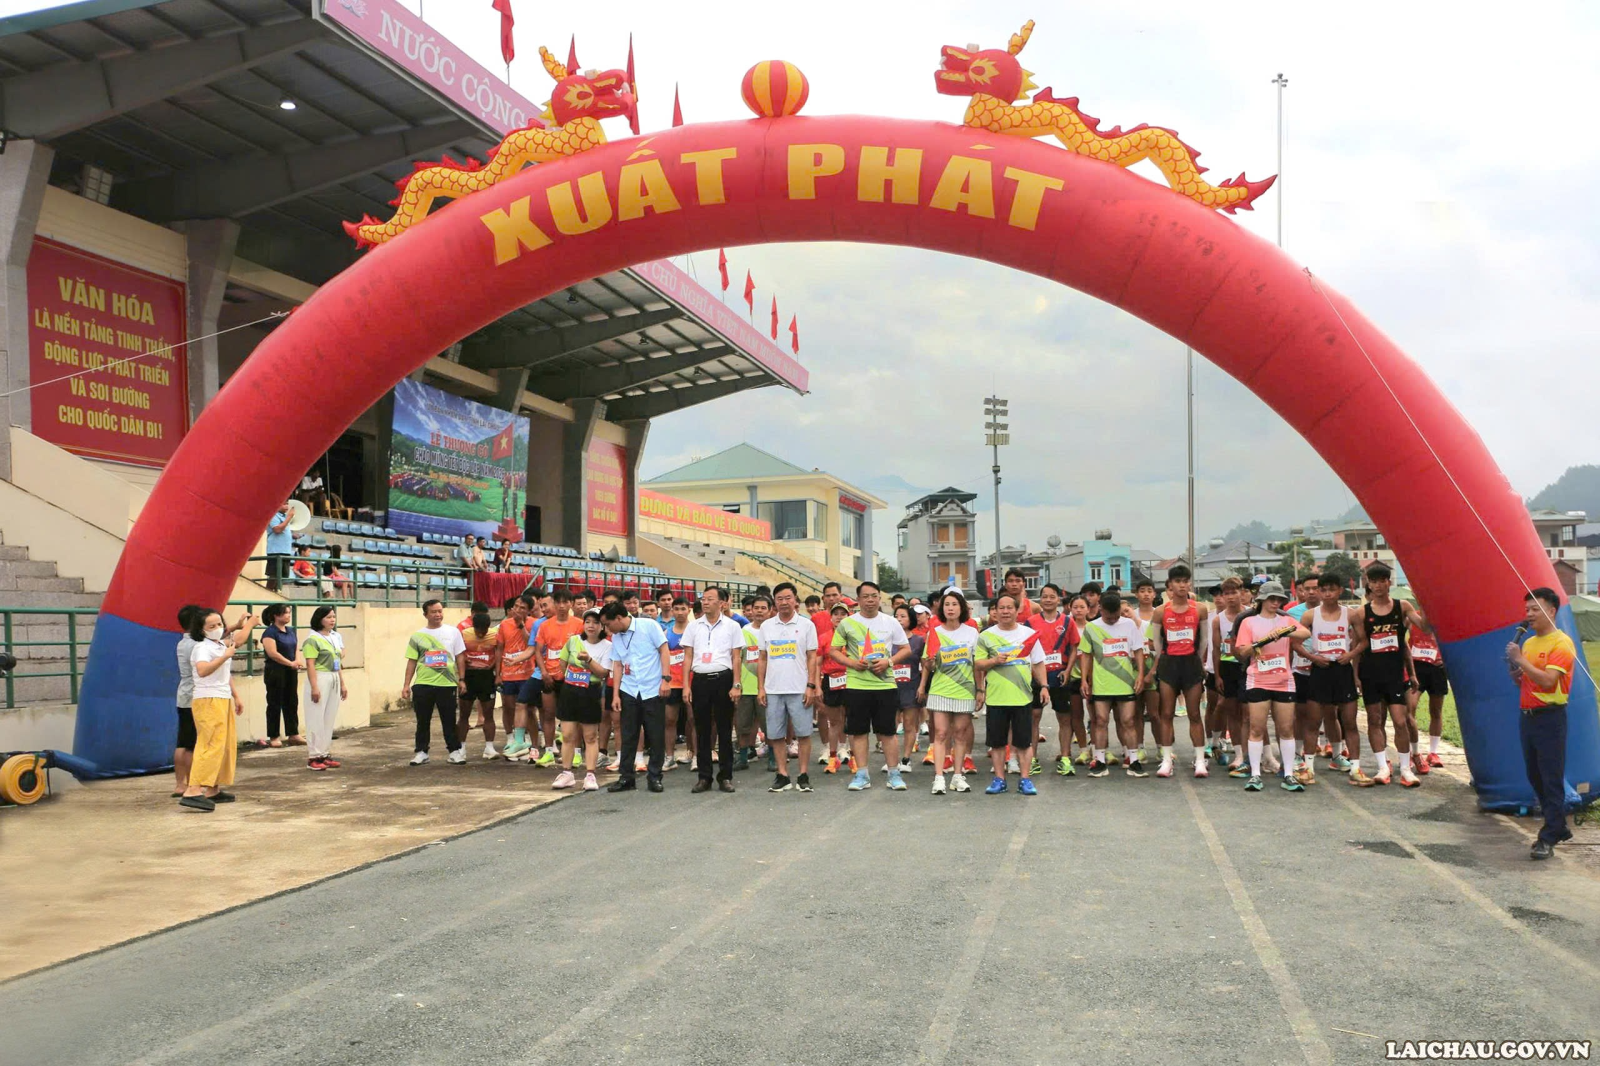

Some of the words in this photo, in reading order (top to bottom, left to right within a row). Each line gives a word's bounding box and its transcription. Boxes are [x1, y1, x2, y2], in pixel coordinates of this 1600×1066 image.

[378, 9, 457, 86] NƯỚC
[461, 73, 528, 130] CỘNG
[479, 136, 738, 267] XUẤT
[787, 142, 1065, 232] PHÁT
[58, 276, 105, 312] VĂN
[112, 294, 155, 326] HÓA
[651, 263, 678, 292] CHỦ
[680, 281, 714, 320] NGHĨA
[35, 308, 51, 328] LÀ
[55, 311, 80, 337] NỀN
[83, 317, 114, 346] TẢNG
[117, 326, 142, 351] TINH
[145, 332, 176, 362] THẦN,
[44, 341, 79, 367] ĐỘNG
[82, 349, 105, 373] LỰC
[107, 352, 138, 378] PHÁT
[139, 358, 170, 387] TRIỂN
[70, 376, 86, 398] VÀ
[89, 381, 109, 402] SOI
[112, 385, 150, 411] ĐƯỜNG
[58, 404, 84, 424] CHO
[87, 408, 118, 433] QUỐC
[120, 412, 145, 437] DÂN
[430, 428, 442, 447] LỄ
[443, 434, 476, 457] THƯỢNG
[476, 442, 489, 459] CỜ
[676, 503, 690, 521] VÀ
[692, 507, 712, 526] BẢO
[714, 513, 725, 532] VỆ
[728, 514, 739, 531] TỔ
